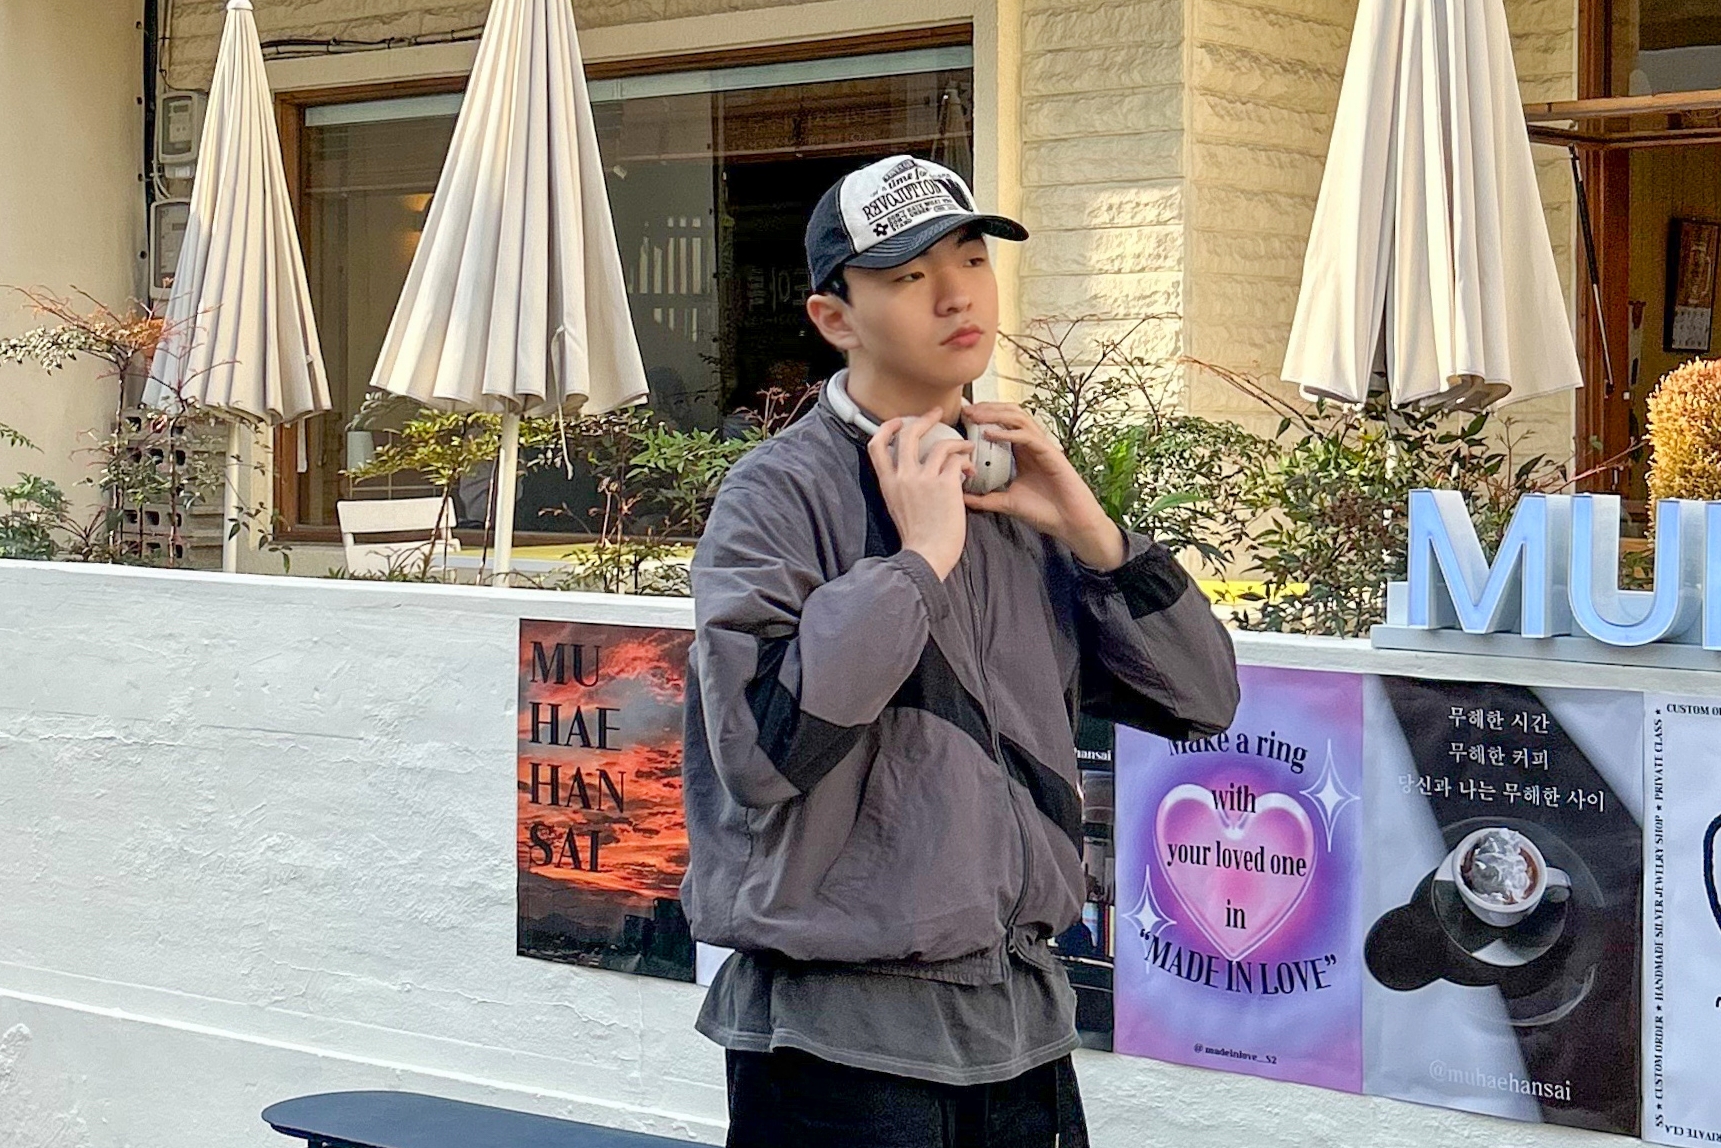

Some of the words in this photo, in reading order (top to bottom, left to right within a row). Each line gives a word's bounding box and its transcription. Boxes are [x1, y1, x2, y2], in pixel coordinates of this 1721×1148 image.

[888, 172, 913, 189] time
[530, 641, 600, 687] MU
[529, 701, 622, 751] HAE
[1448, 706, 1505, 730] 무해한
[1511, 712, 1550, 734] 시간
[1666, 704, 1709, 715] CUSTOM
[1236, 733, 1250, 754] a
[1256, 731, 1308, 774] ring
[1654, 718, 1663, 753] CLASS
[1449, 742, 1505, 766] 무해한
[1512, 748, 1549, 770] 커피
[529, 762, 626, 813] HAN
[1398, 774, 1452, 798] 당신과
[1459, 779, 1496, 801] 나는
[1502, 782, 1561, 808] 무해한
[1566, 788, 1605, 812] 사이
[1654, 756, 1663, 800] PRIVATE
[1211, 783, 1256, 813] with
[529, 822, 608, 873] SAI
[1655, 815, 1663, 844] SHOP
[1167, 843, 1211, 867] your
[1216, 840, 1265, 873] loved
[1270, 853, 1307, 877] one
[1654, 846, 1664, 897] JEWELRY
[1225, 899, 1246, 929] in
[1654, 900, 1663, 938] SILVER
[1226, 960, 1252, 994] IN
[1654, 940, 1663, 1001] HANDMADE
[1655, 1015, 1663, 1052] ORDER
[1429, 1060, 1571, 1101] @muhaehansai
[1654, 1054, 1663, 1100] CUSTOM
